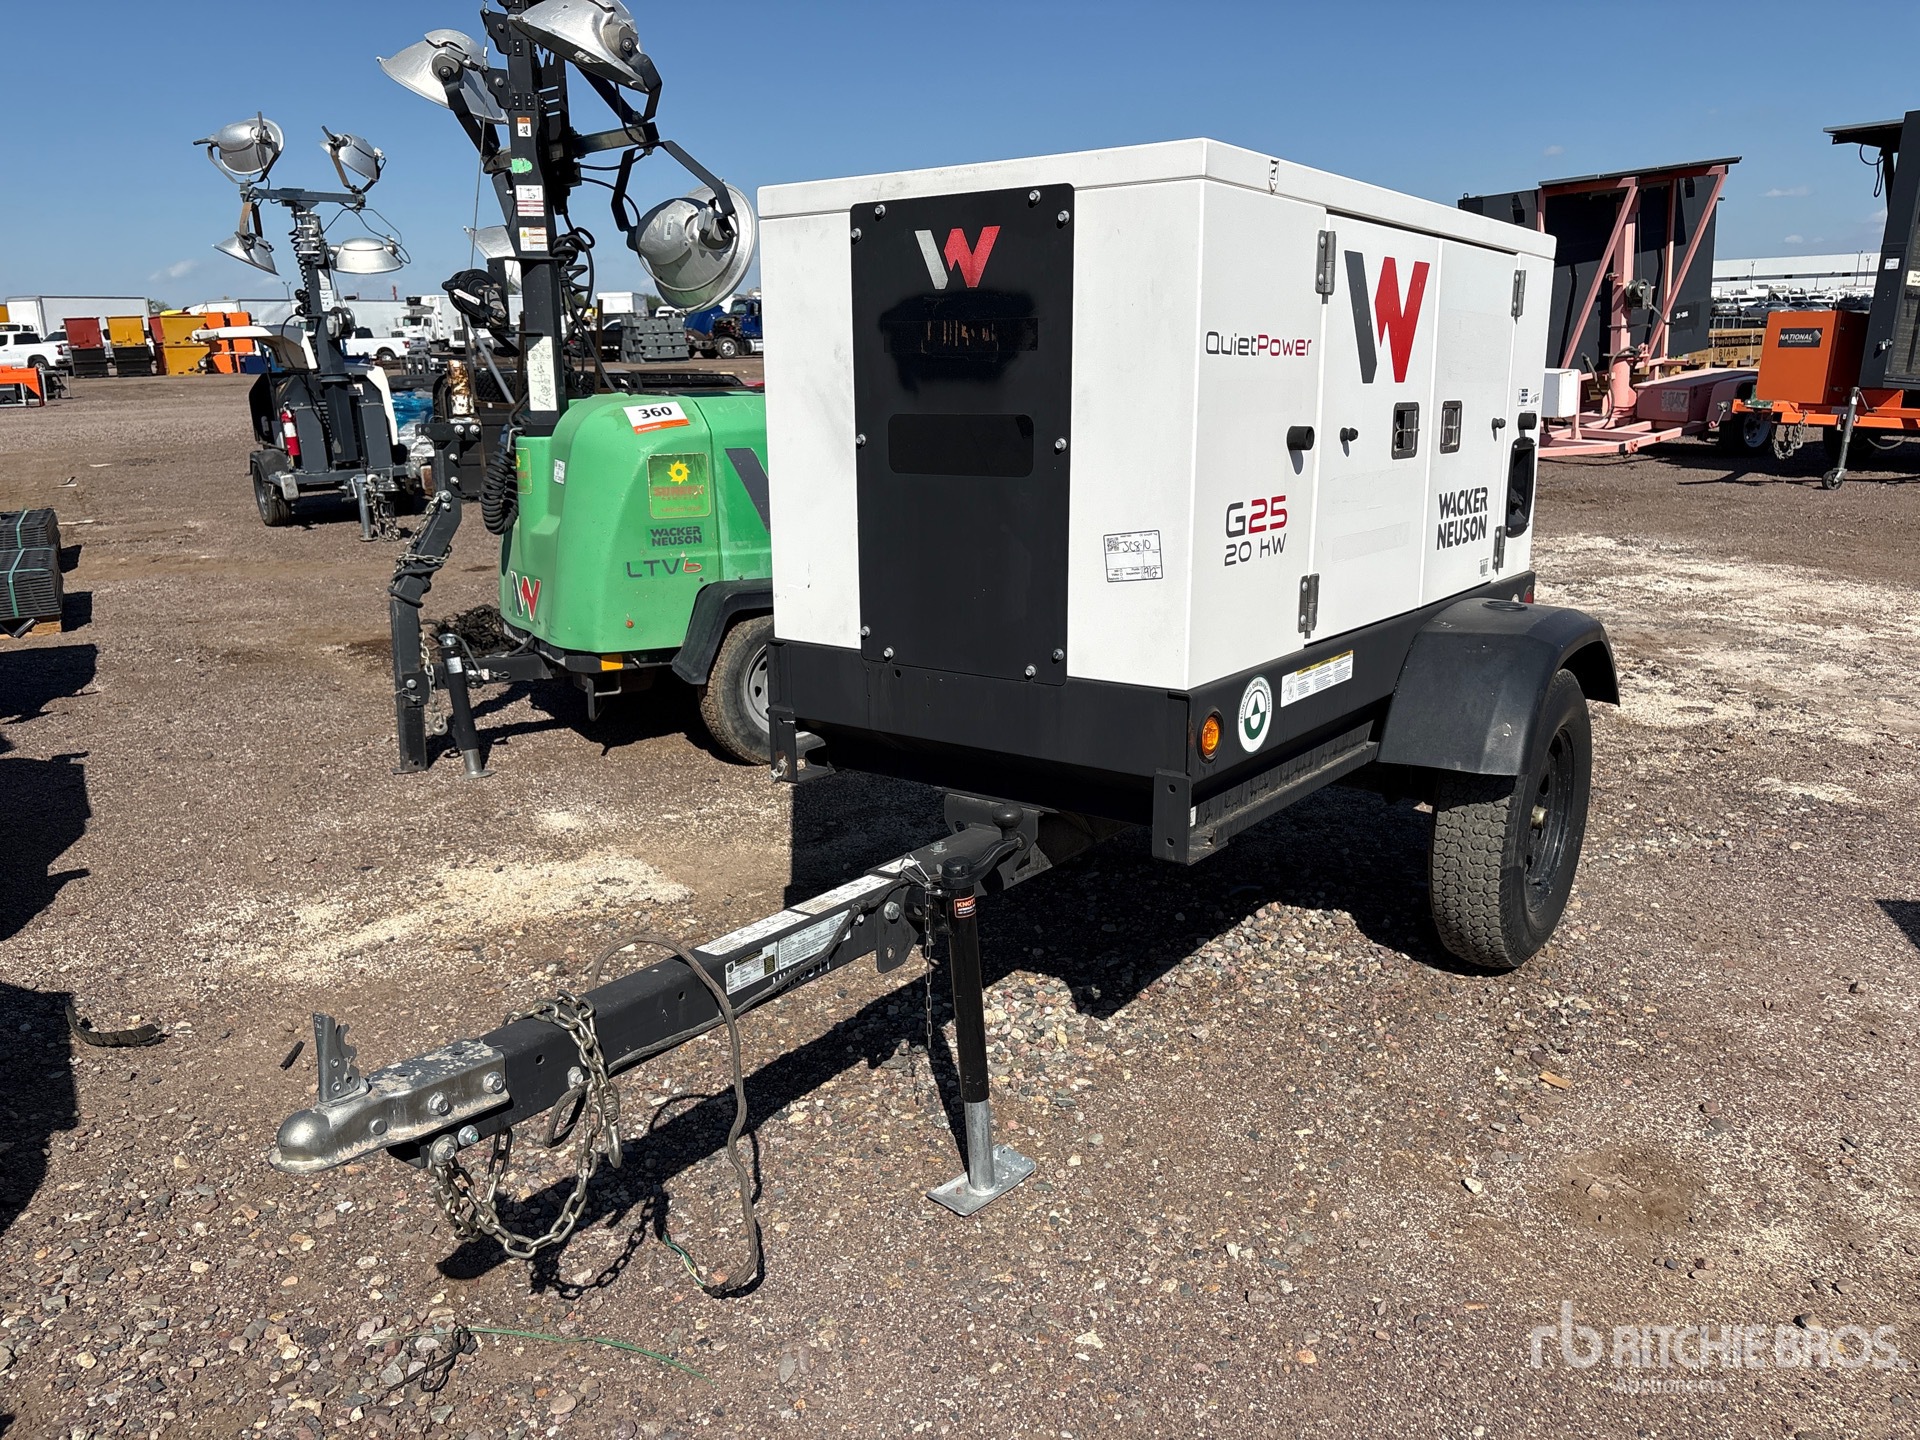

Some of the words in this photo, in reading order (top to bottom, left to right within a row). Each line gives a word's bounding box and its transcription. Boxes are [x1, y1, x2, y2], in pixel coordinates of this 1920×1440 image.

[1205, 331, 1312, 357] QuietPower
[1779, 333, 1813, 341] NATIONAL
[638, 406, 673, 419] 360
[1438, 486, 1488, 520] WACKER
[1225, 495, 1288, 538] G25
[650, 526, 702, 538] WACKER
[651, 534, 703, 547] NEUSON
[1437, 514, 1487, 550] NEUSON
[1224, 541, 1252, 567] 20
[626, 558, 702, 578] LTV6
